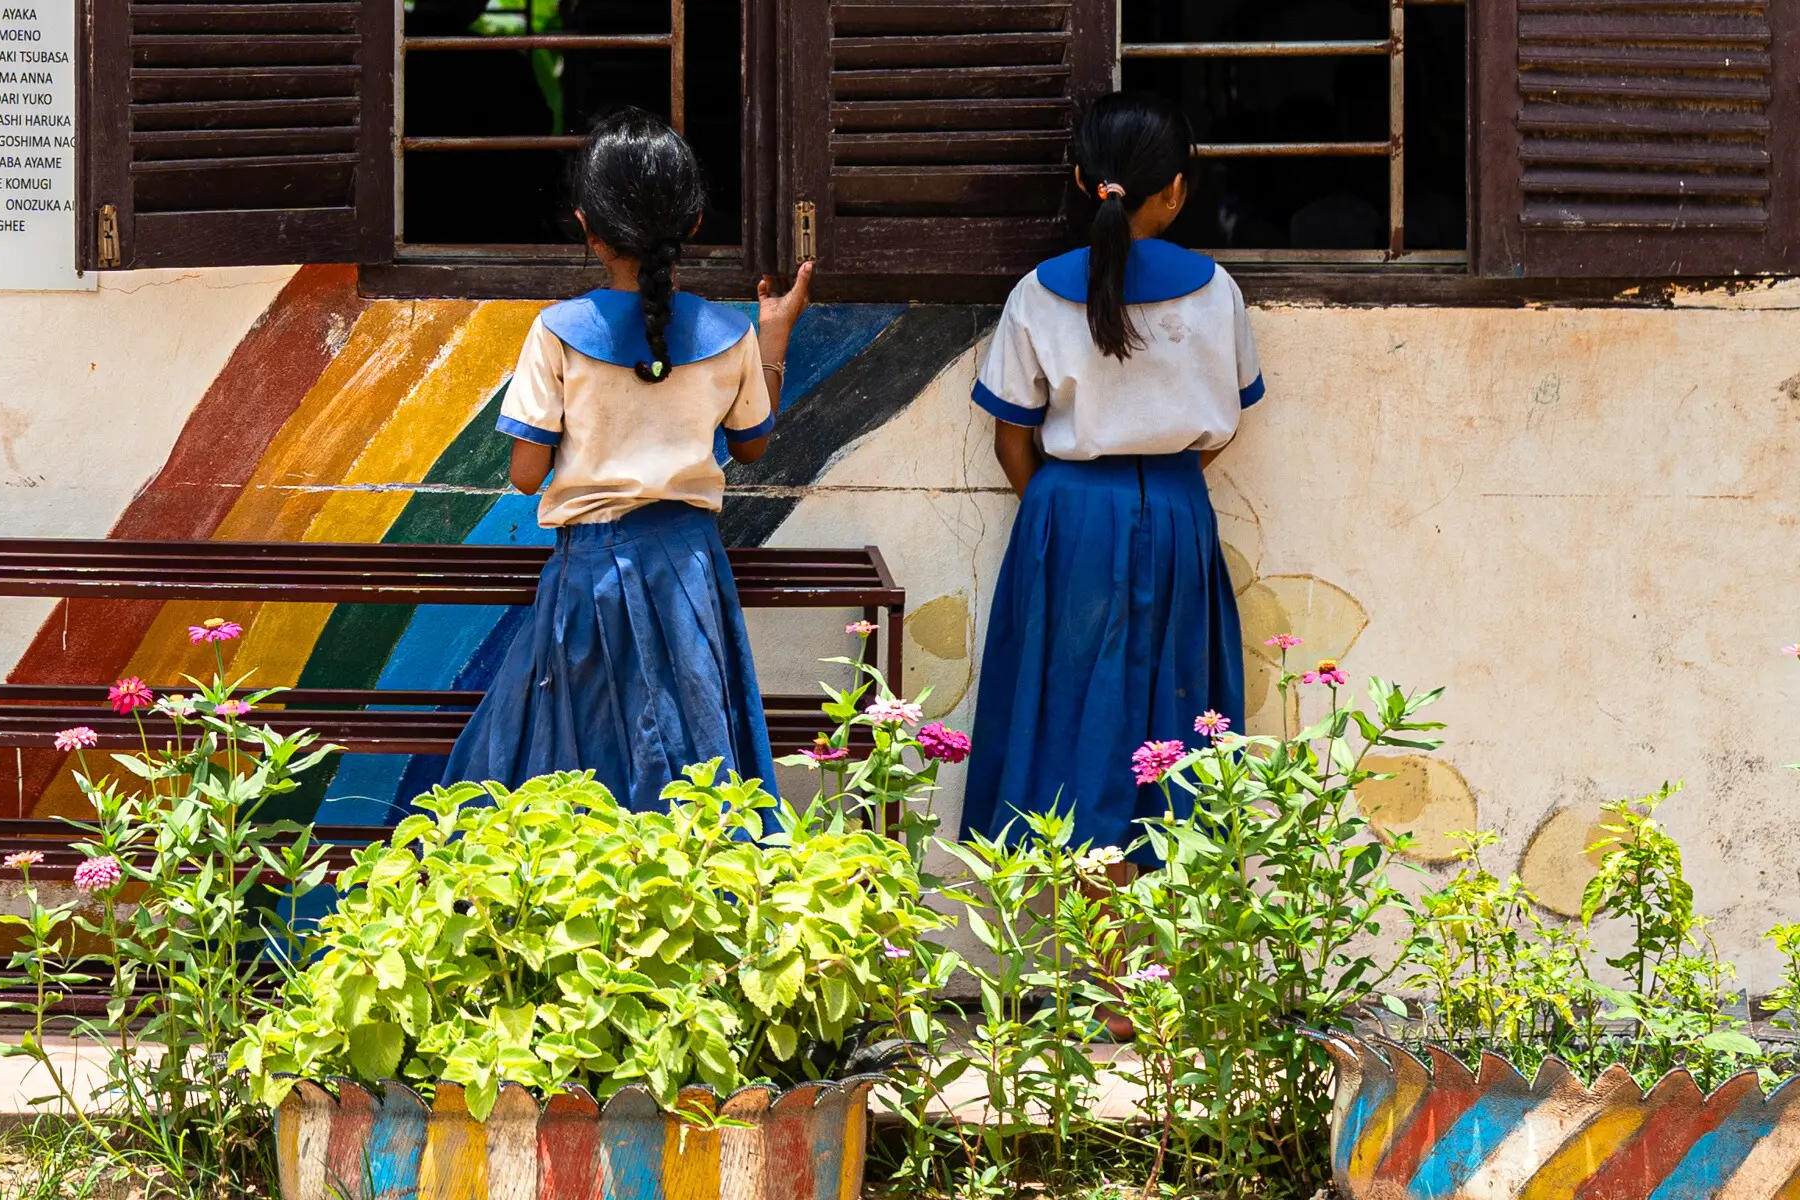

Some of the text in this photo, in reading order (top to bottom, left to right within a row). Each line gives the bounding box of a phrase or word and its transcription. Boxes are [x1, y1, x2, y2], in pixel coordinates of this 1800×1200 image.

[2, 7, 37, 20] AYAKA
[19, 50, 69, 64] TSUBASA
[20, 71, 53, 84] ANNA
[22, 92, 52, 105] YUKO
[25, 114, 72, 127] HARUKA
[24, 156, 62, 169] AYAME
[5, 177, 51, 190] KOMUGI
[6, 198, 61, 211] ONOZUKA
